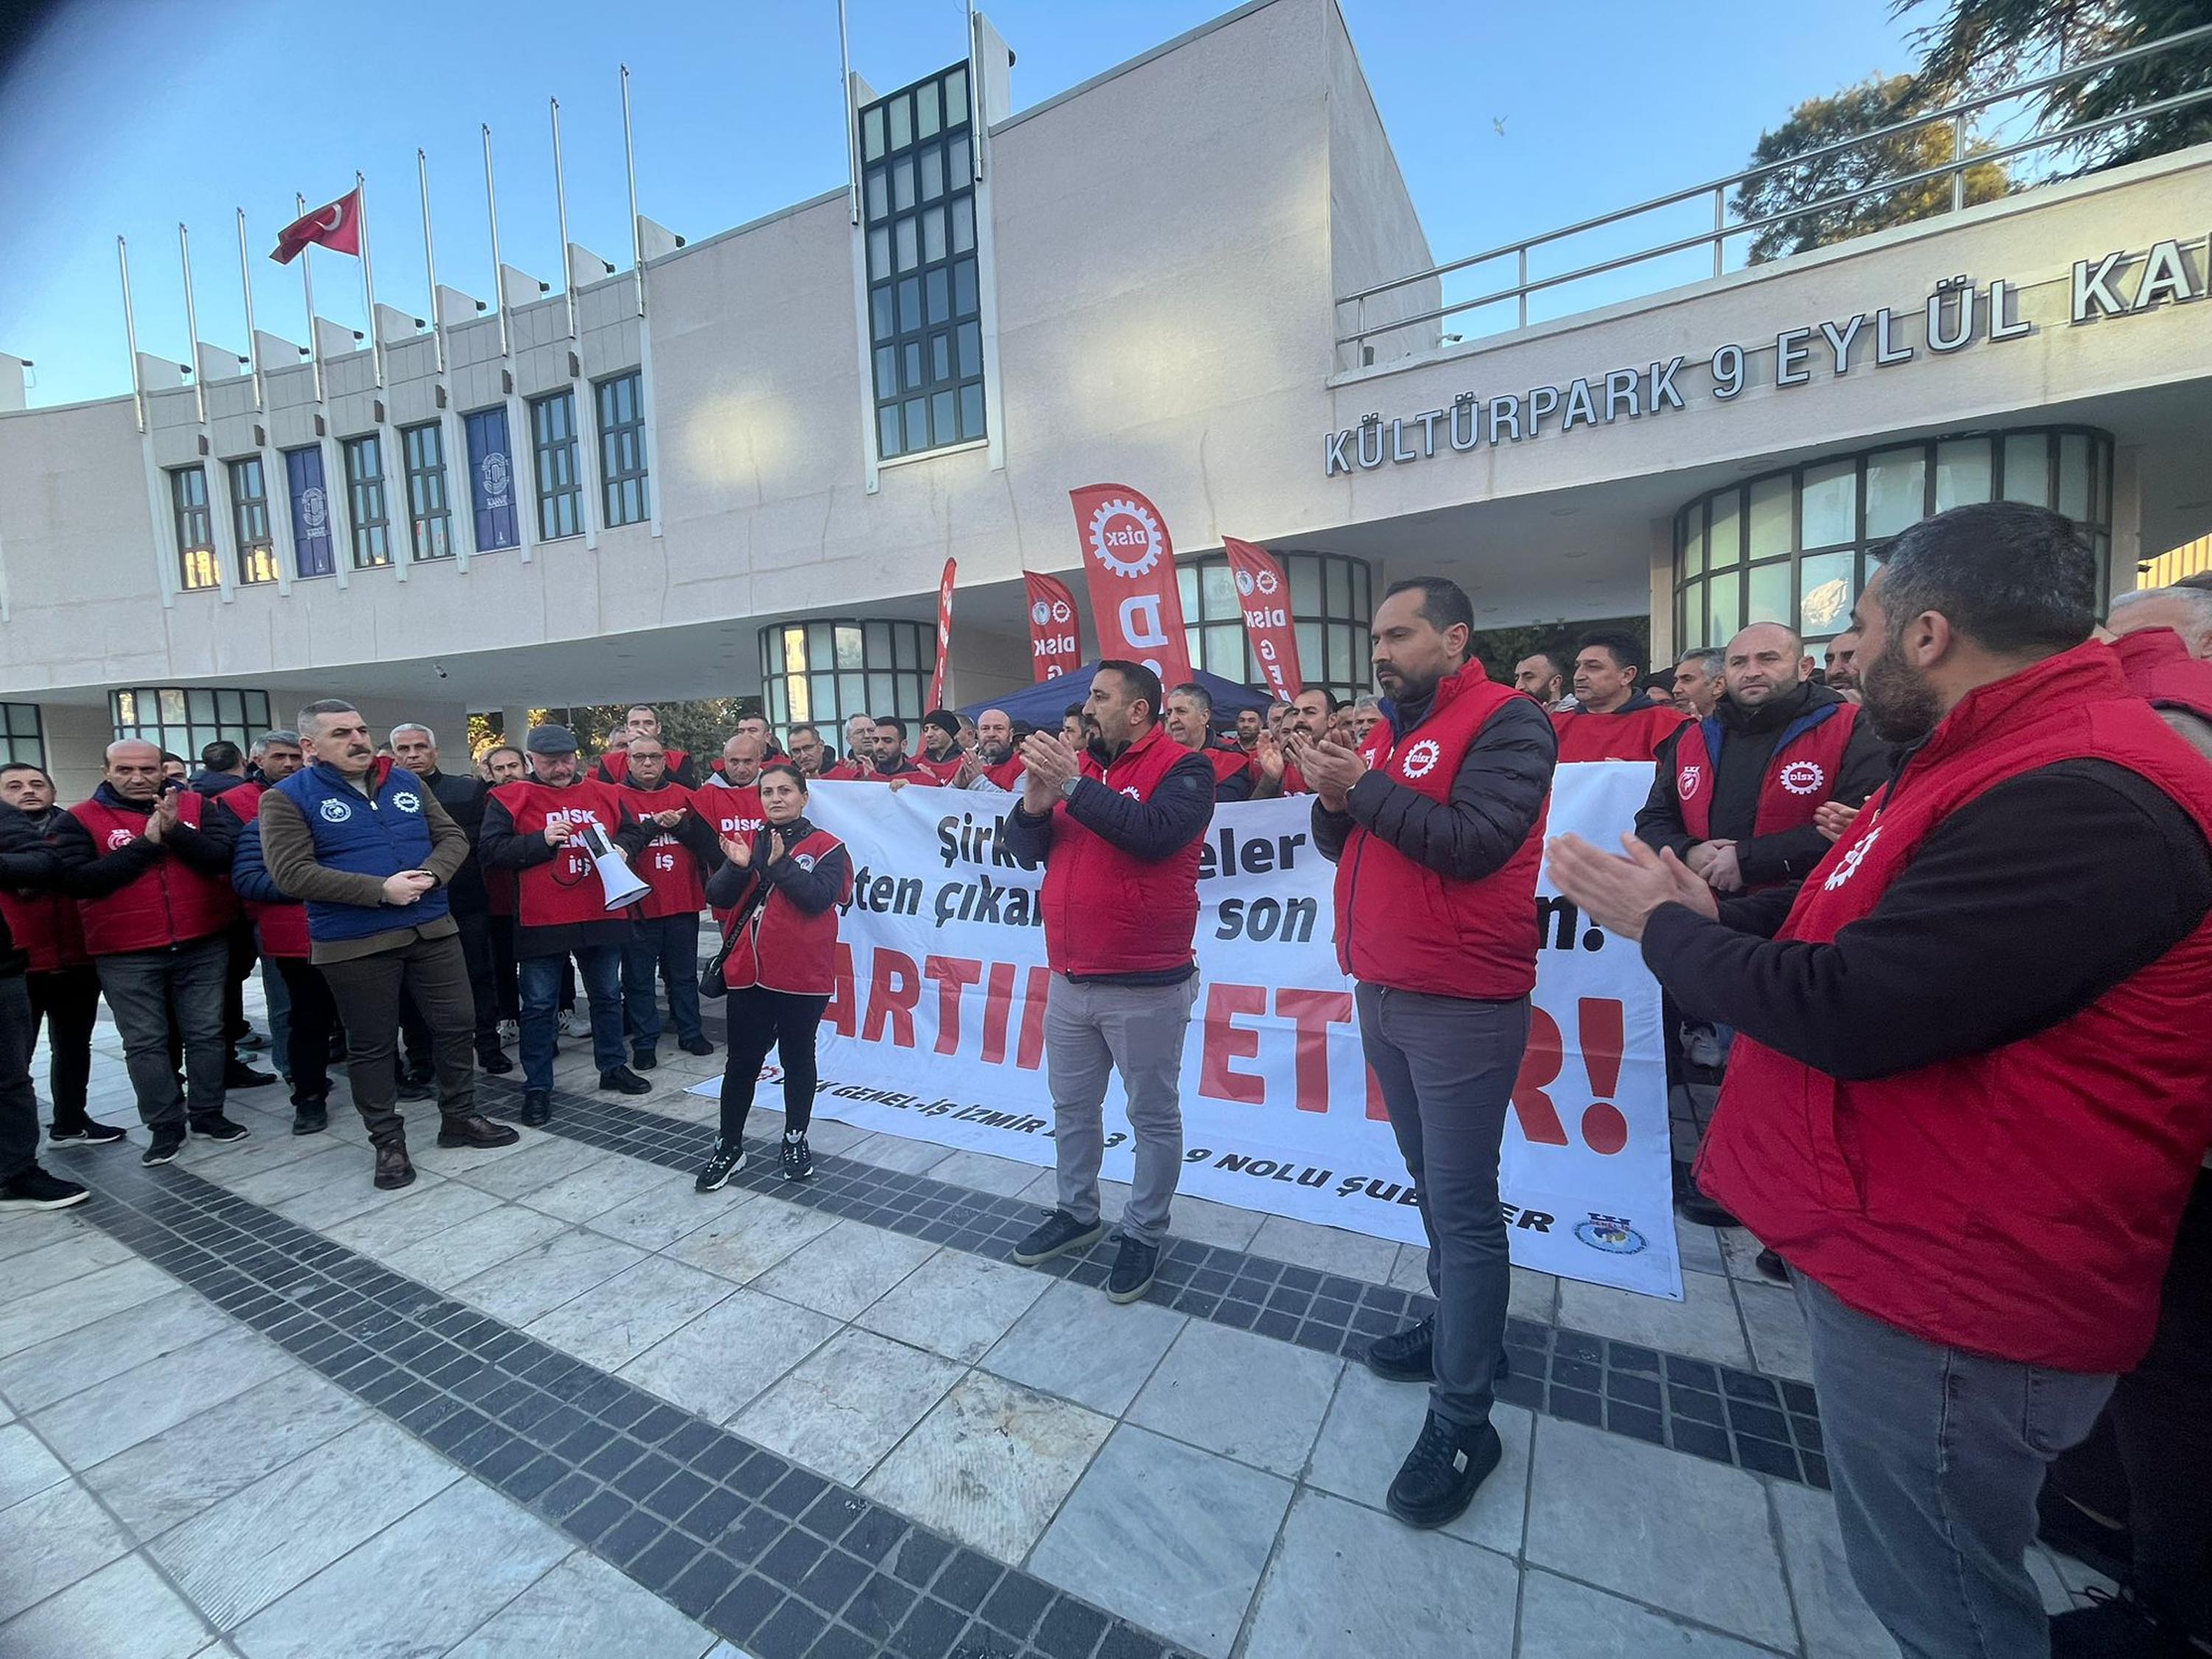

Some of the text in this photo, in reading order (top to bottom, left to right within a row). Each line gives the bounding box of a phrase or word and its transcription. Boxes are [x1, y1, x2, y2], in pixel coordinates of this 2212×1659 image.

[1326, 232, 2212, 476] KÜLTÜRPARK 9 EYLÜL KA
[1790, 771, 1815, 781] DİSK
[546, 806, 599, 826] DİSK
[720, 815, 763, 832] DİSK
[655, 852, 674, 872] İŞ
[1215, 897, 1318, 942] son
[832, 1086, 958, 1117] GENEL-İŞ
[950, 1105, 1047, 1133] İZMİR
[1214, 1153, 1333, 1188] NOLU
[1336, 1176, 1555, 1233] ŞUBER
